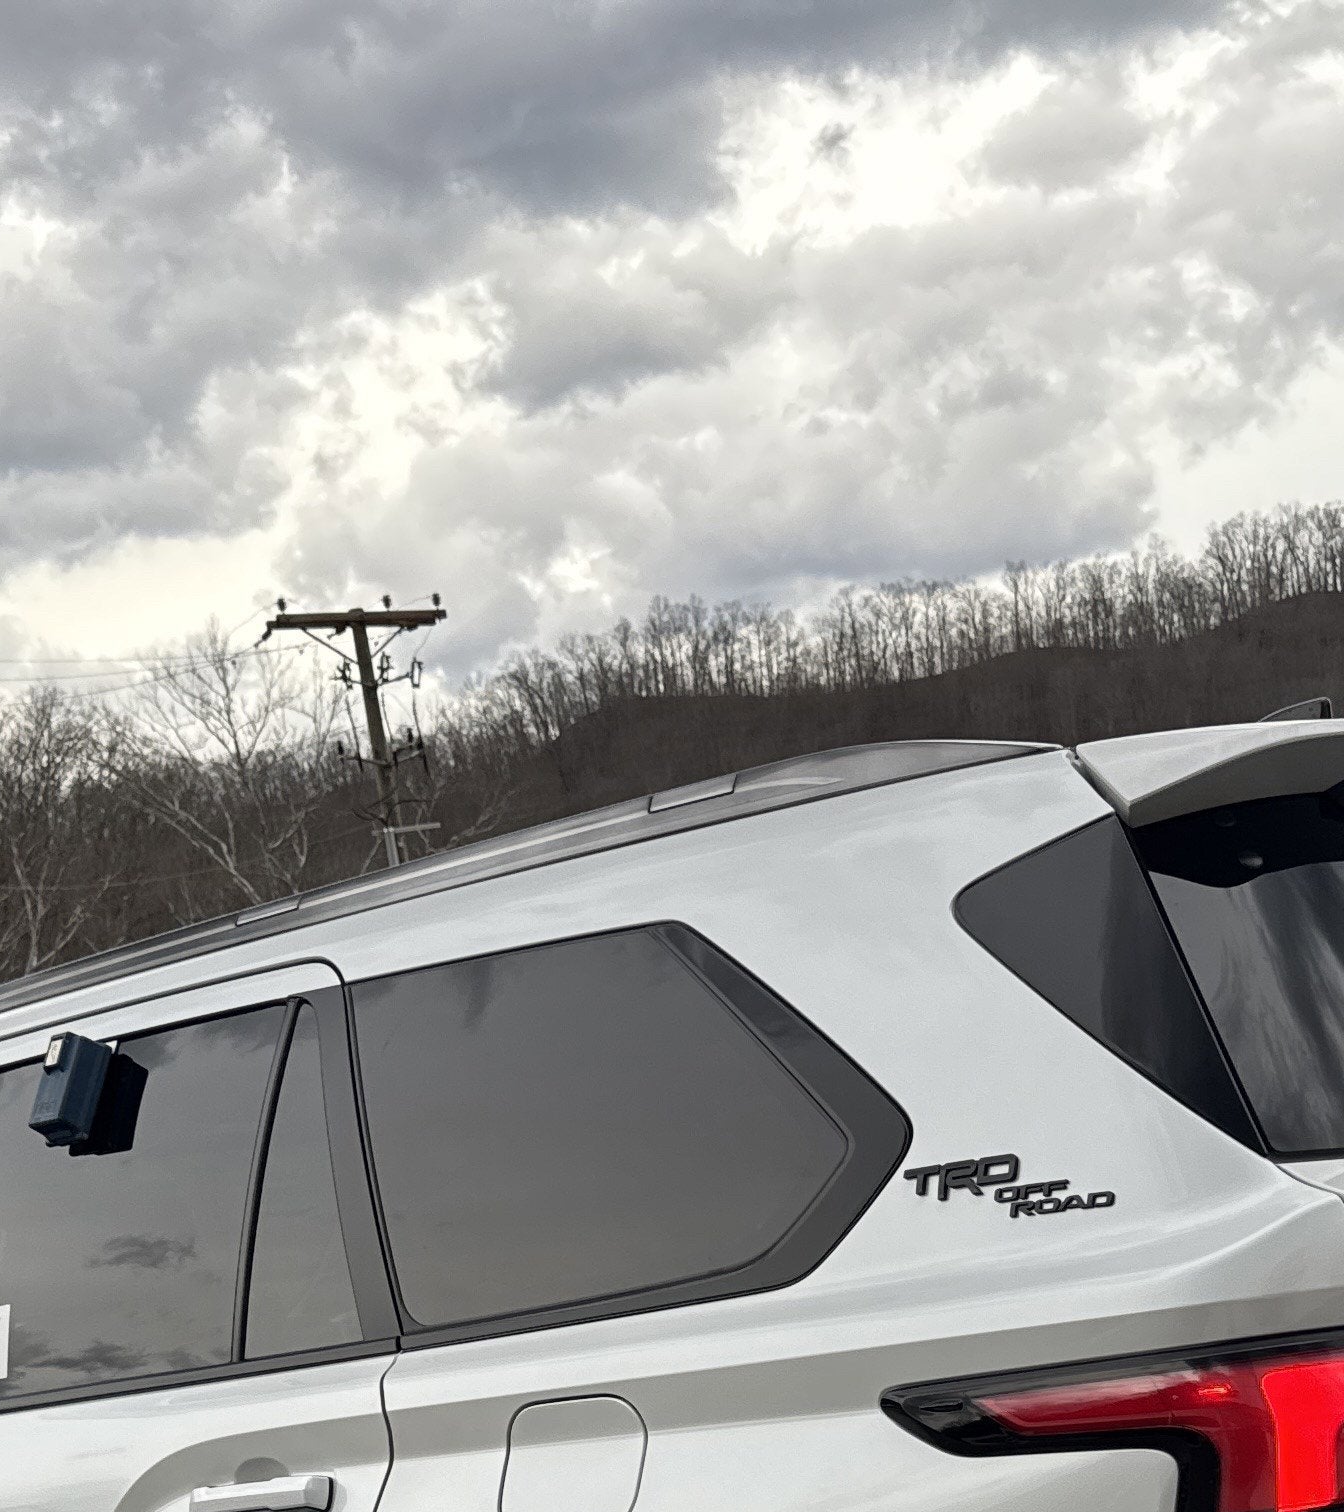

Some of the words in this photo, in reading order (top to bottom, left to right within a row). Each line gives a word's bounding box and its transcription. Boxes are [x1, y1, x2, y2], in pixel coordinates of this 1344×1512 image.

[903, 1153, 1019, 1201] TRD
[994, 1179, 1070, 1203] OFF
[1009, 1190, 1116, 1219] ROAD
